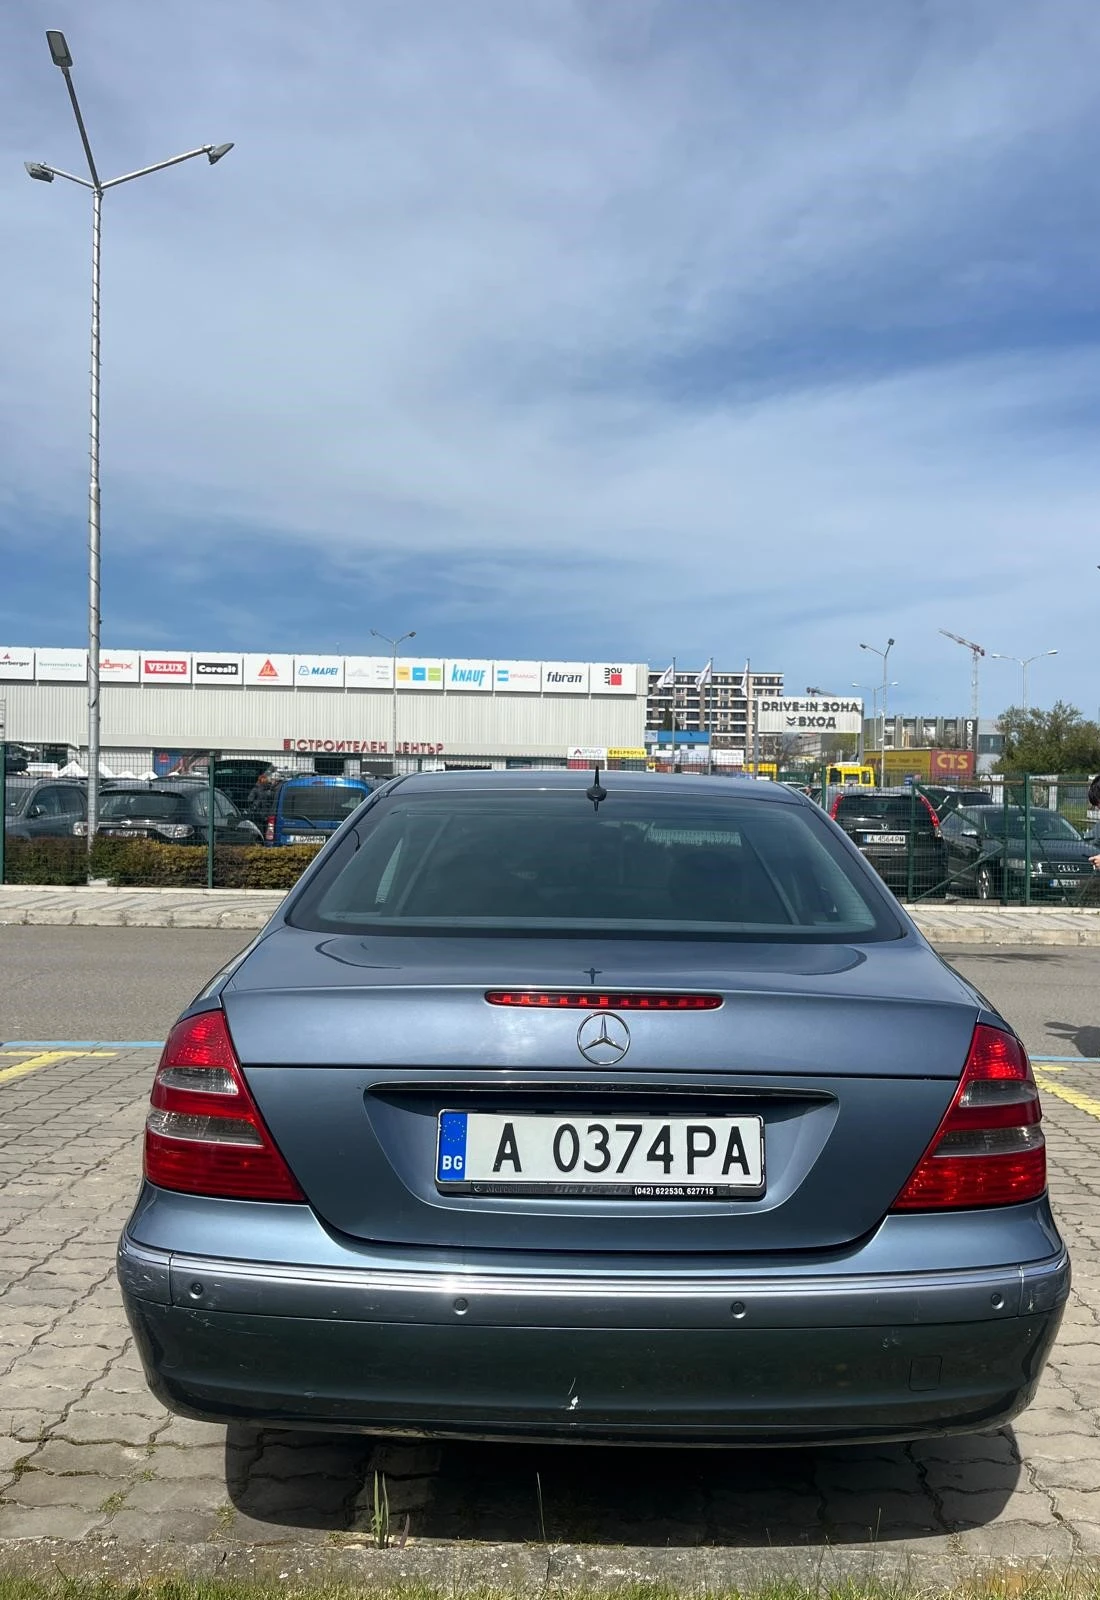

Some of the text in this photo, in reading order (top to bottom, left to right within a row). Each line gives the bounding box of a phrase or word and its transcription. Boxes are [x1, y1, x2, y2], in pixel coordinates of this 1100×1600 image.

[147, 663, 184, 673] VELUX
[198, 664, 237, 674] Ceresit
[311, 667, 338, 676] MAPEI
[451, 663, 487, 687] KNAUF
[546, 671, 583, 683] fibran
[761, 701, 860, 713] DRIVE-IN ЗОНА
[798, 716, 837, 729] ВХОД
[296, 739, 388, 753] СТРОИТЕЛЕН
[936, 753, 969, 769] CTS
[492, 1122, 522, 1173] A
[441, 1156, 463, 1170] BG
[634, 1185, 654, 1196] (042)
[655, 1186, 685, 1196] 622530,
[686, 1187, 714, 1195] 627715
